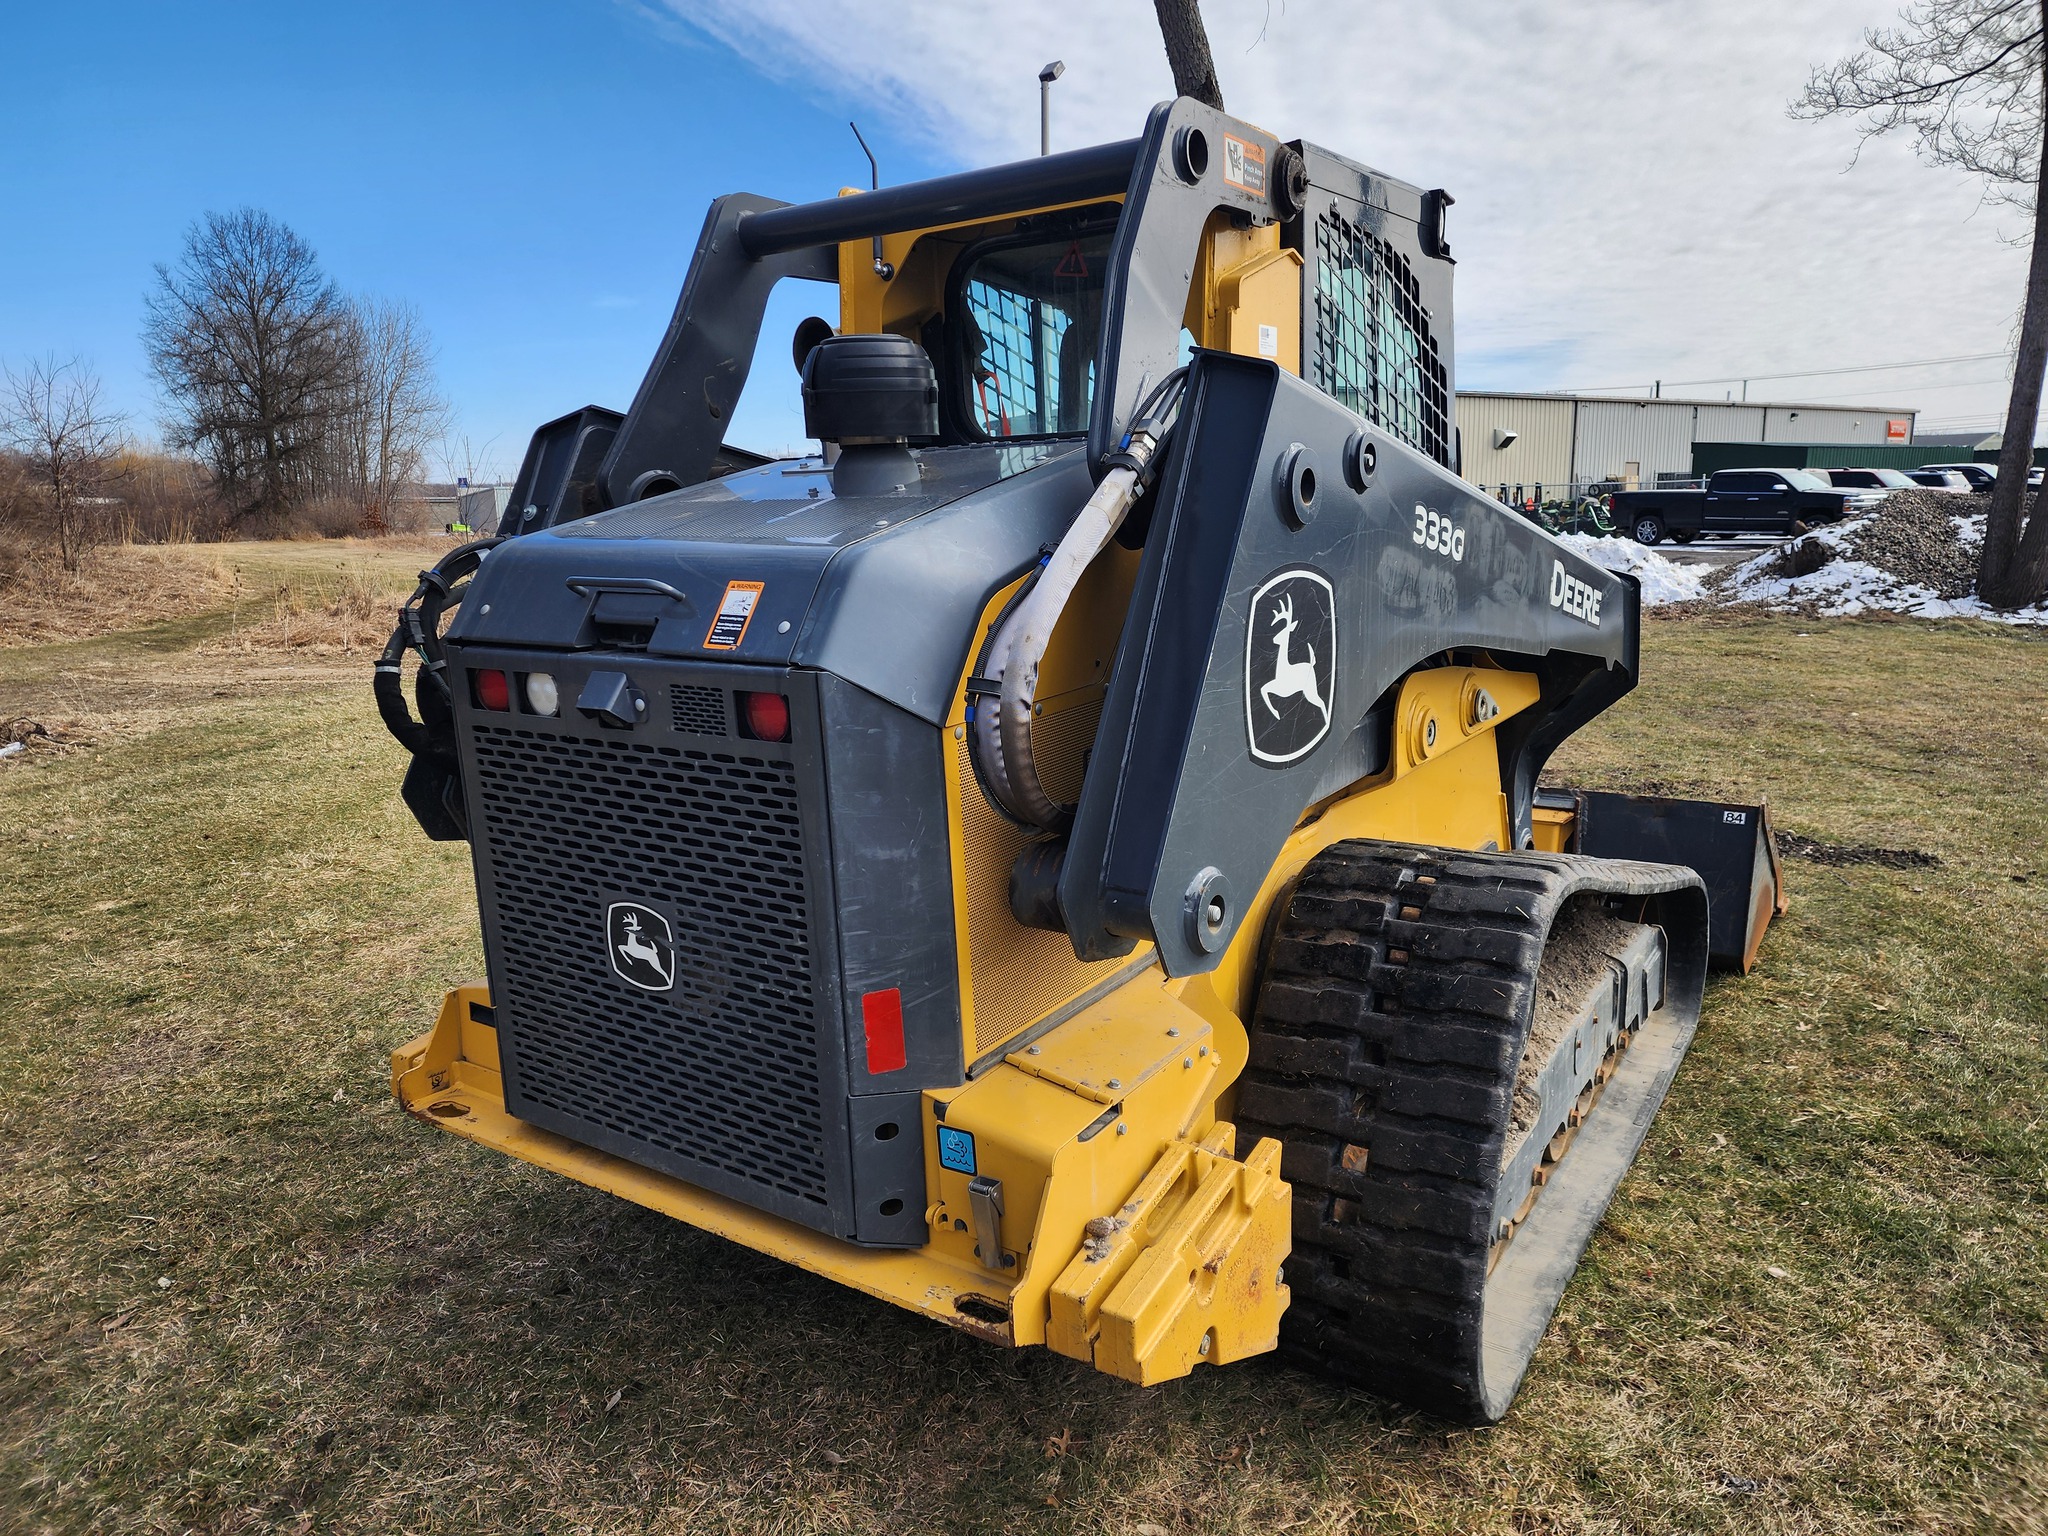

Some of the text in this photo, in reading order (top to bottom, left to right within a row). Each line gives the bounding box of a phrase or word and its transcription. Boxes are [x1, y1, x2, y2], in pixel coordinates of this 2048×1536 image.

[1412, 503, 1465, 562] 333G
[1550, 560, 1602, 626] DEERE
[1726, 813, 1743, 823] 84
